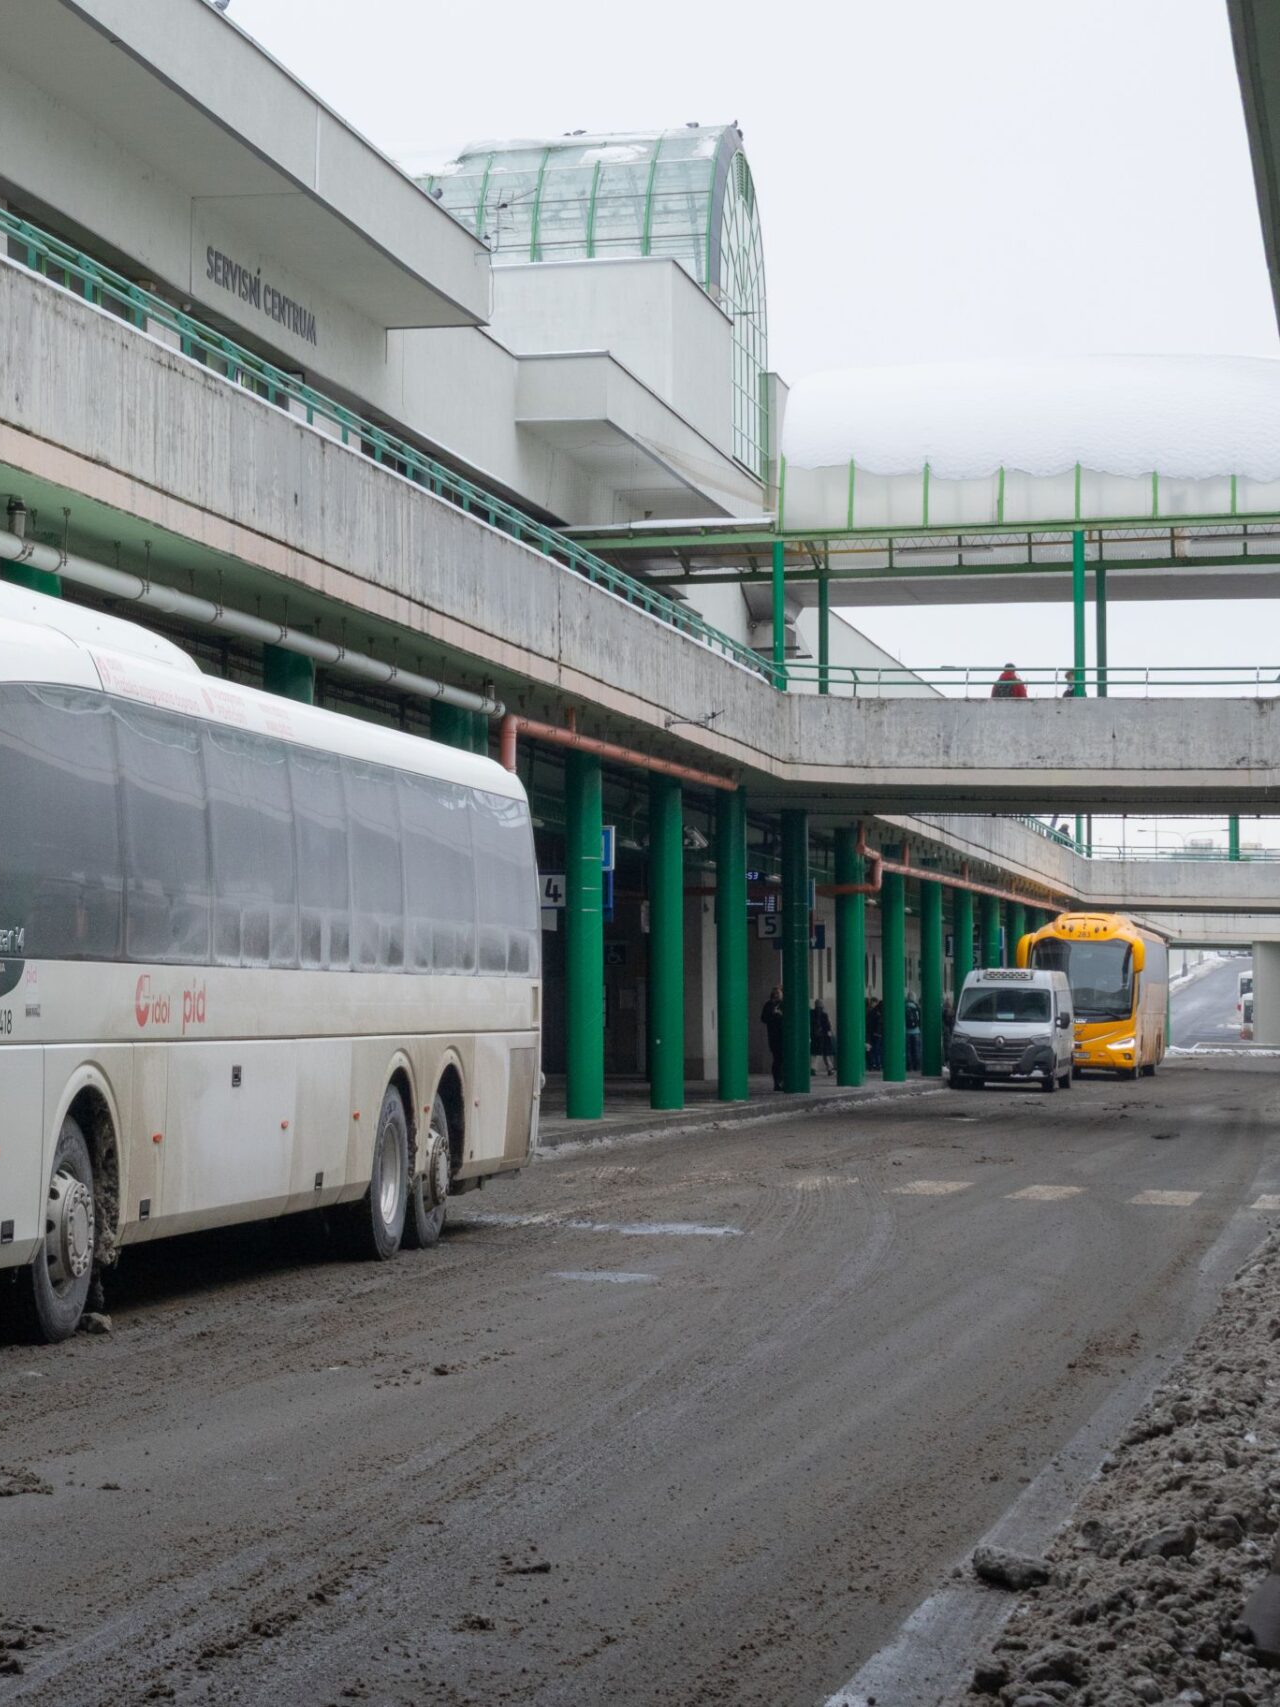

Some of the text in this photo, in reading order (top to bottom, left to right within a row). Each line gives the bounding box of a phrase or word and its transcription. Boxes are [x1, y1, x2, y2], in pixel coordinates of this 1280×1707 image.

[206, 246, 317, 346] SERVISNÍ CENTRUM
[545, 878, 562, 903] 4
[764, 916, 777, 935] 5
[182, 978, 206, 1035] pid
